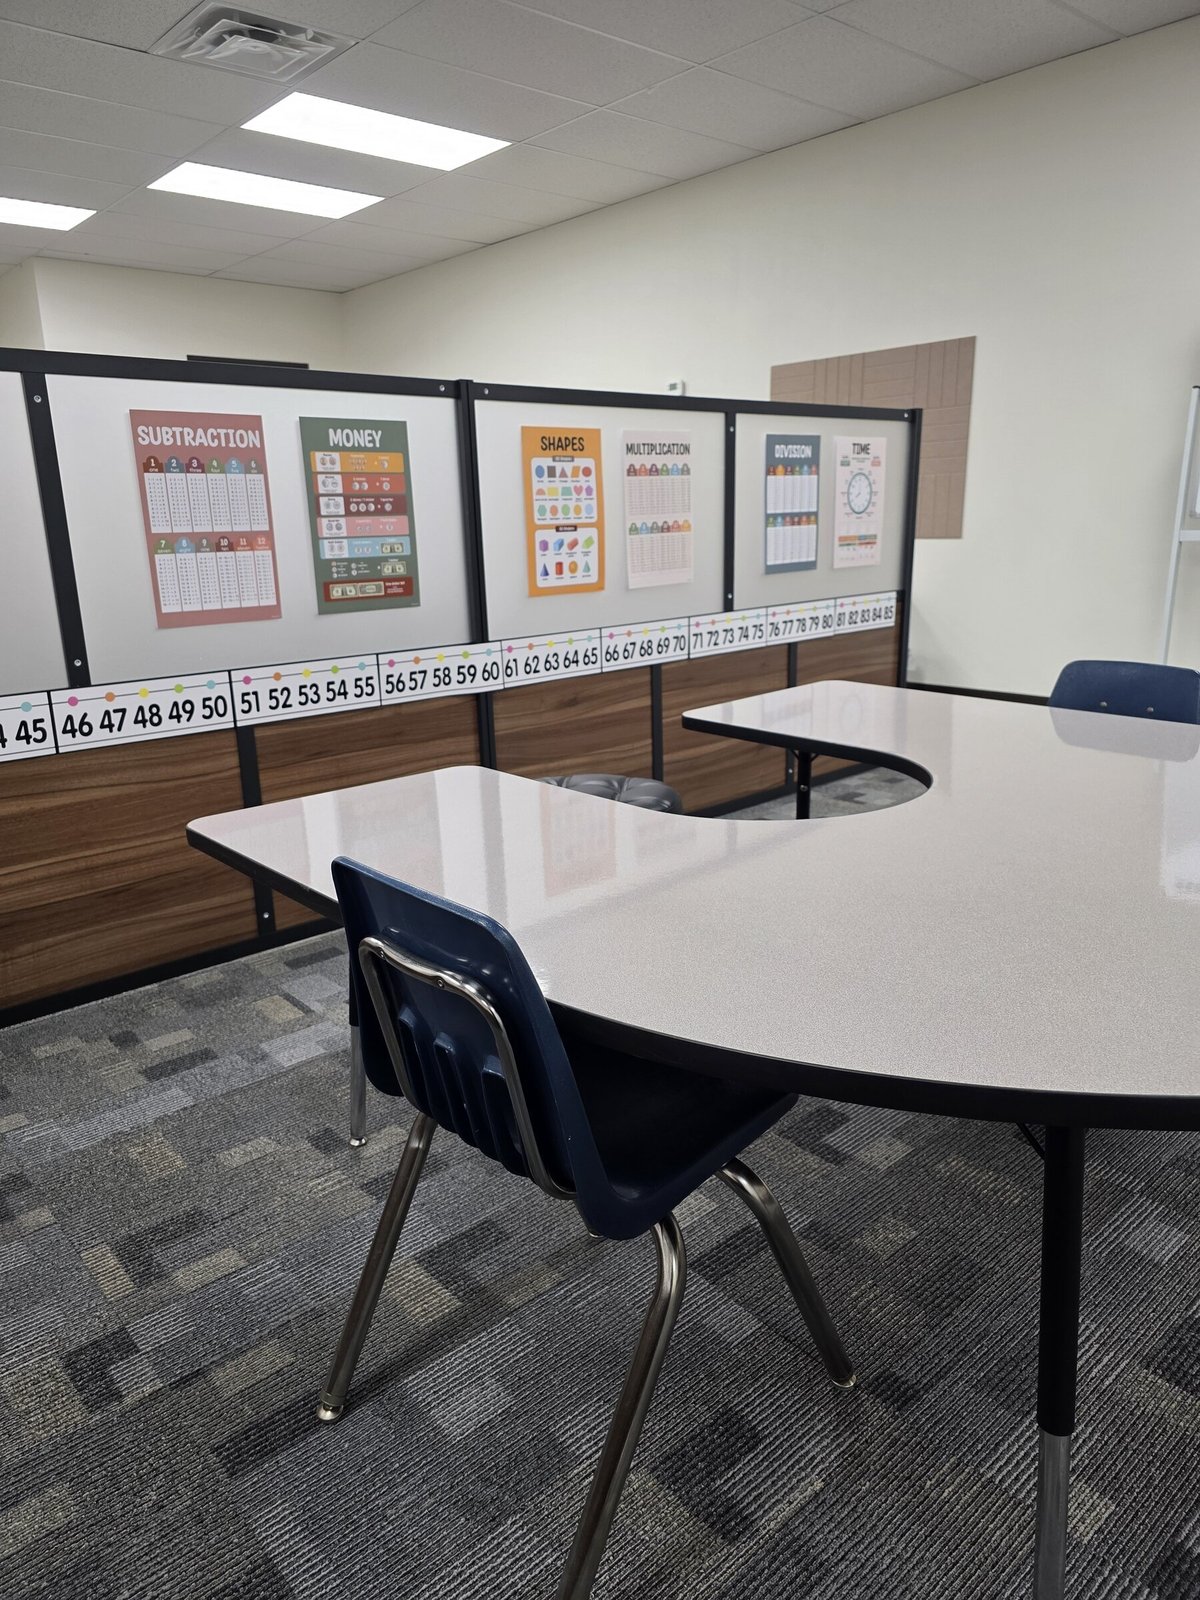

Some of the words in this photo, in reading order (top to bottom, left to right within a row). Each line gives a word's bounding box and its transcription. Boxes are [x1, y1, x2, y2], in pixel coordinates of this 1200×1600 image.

[137, 425, 261, 448] SUBTRACTION
[328, 428, 382, 448] MONEY
[540, 435, 585, 452] SHAPES
[626, 442, 691, 456] MULTIPLICATION
[774, 444, 813, 459] DIVISION
[852, 442, 871, 455] TIME
[150, 458, 156, 467] 1
[171, 458, 177, 467] 2
[191, 459, 198, 468] 3
[212, 459, 218, 468] 4
[231, 460, 238, 468] 5
[160, 539, 166, 548] 7
[202, 538, 207, 547] 9
[220, 538, 229, 546] 10
[240, 537, 248, 546] 11
[770, 622, 780, 637] 76
[783, 619, 794, 635] 77
[796, 617, 807, 633] 78
[809, 615, 820, 631] 79
[822, 613, 834, 630] 80
[837, 612, 846, 627] 81
[849, 610, 859, 626] 82
[861, 608, 871, 624] 83
[873, 607, 882, 622] 84
[884, 605, 894, 620] 85
[693, 632, 703, 649] 71
[707, 630, 719, 647] 72
[723, 627, 735, 644] 73
[738, 626, 749, 642] 74
[752, 623, 764, 640] 75
[605, 645, 619, 662] 66
[623, 642, 636, 659] 67
[640, 640, 653, 657] 68
[657, 638, 669, 654] 69
[673, 635, 685, 651] 70
[505, 659, 518, 677] 61
[524, 656, 540, 674] 62
[544, 653, 559, 671] 63
[564, 650, 579, 668] 64
[583, 648, 597, 665] 65
[386, 673, 405, 694] 56
[409, 670, 427, 690] 57
[433, 667, 451, 687] 58
[457, 665, 476, 684] 59
[482, 662, 499, 681] 60
[241, 691, 260, 714] 51
[269, 687, 292, 710] 52
[299, 683, 320, 705] 53
[327, 680, 348, 702] 54
[354, 676, 374, 698] 55
[62, 713, 93, 738] 46
[100, 708, 126, 733] 47
[134, 704, 162, 728] 48
[169, 700, 194, 723] 49
[202, 696, 227, 719] 50
[16, 718, 47, 745] 45
